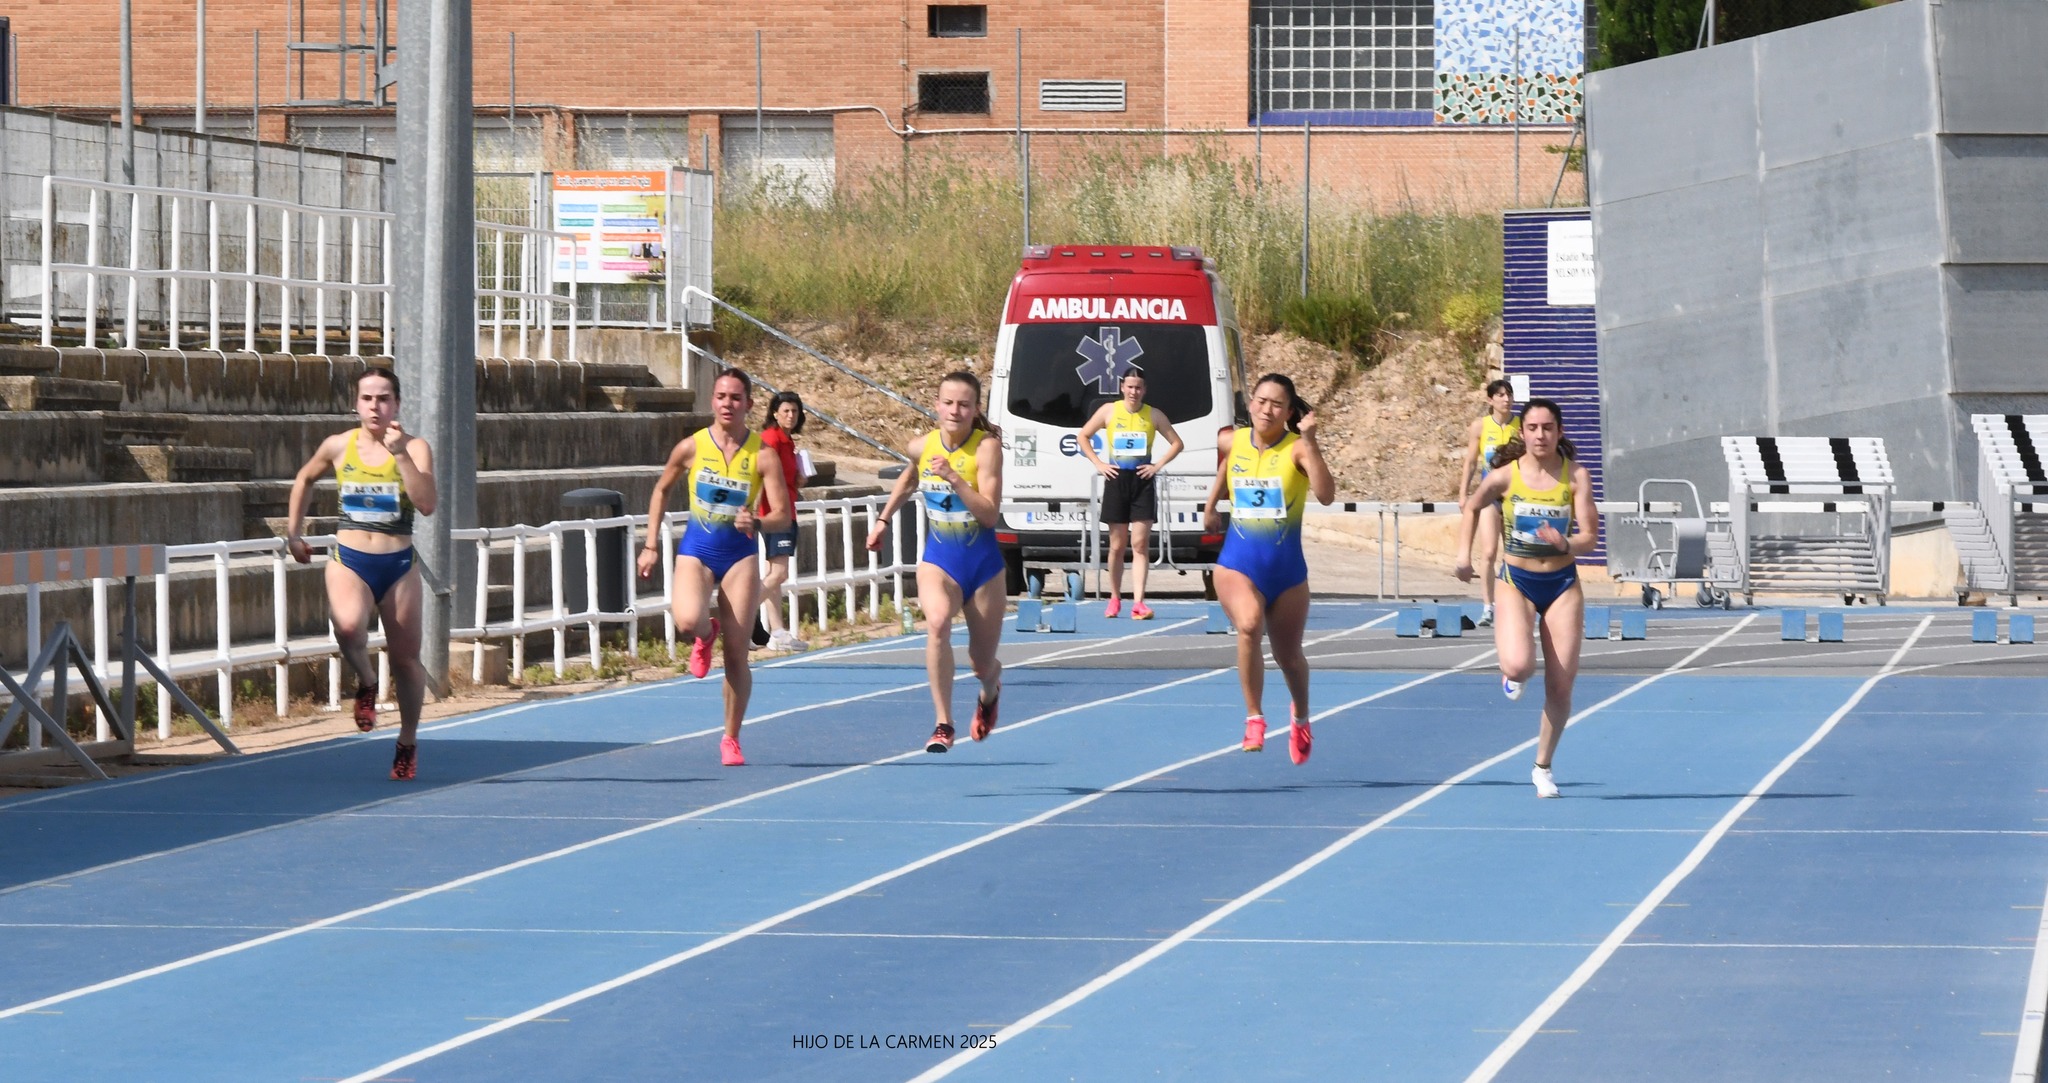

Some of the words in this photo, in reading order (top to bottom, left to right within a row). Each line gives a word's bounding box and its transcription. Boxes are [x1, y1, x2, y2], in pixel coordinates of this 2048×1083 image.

[1555, 268, 1579, 277] NELSON
[1028, 298, 1188, 320] AMBULANCIA
[1125, 439, 1135, 449] 5
[714, 489, 729, 503] 5
[939, 495, 952, 512] 4
[1252, 490, 1265, 507] 3
